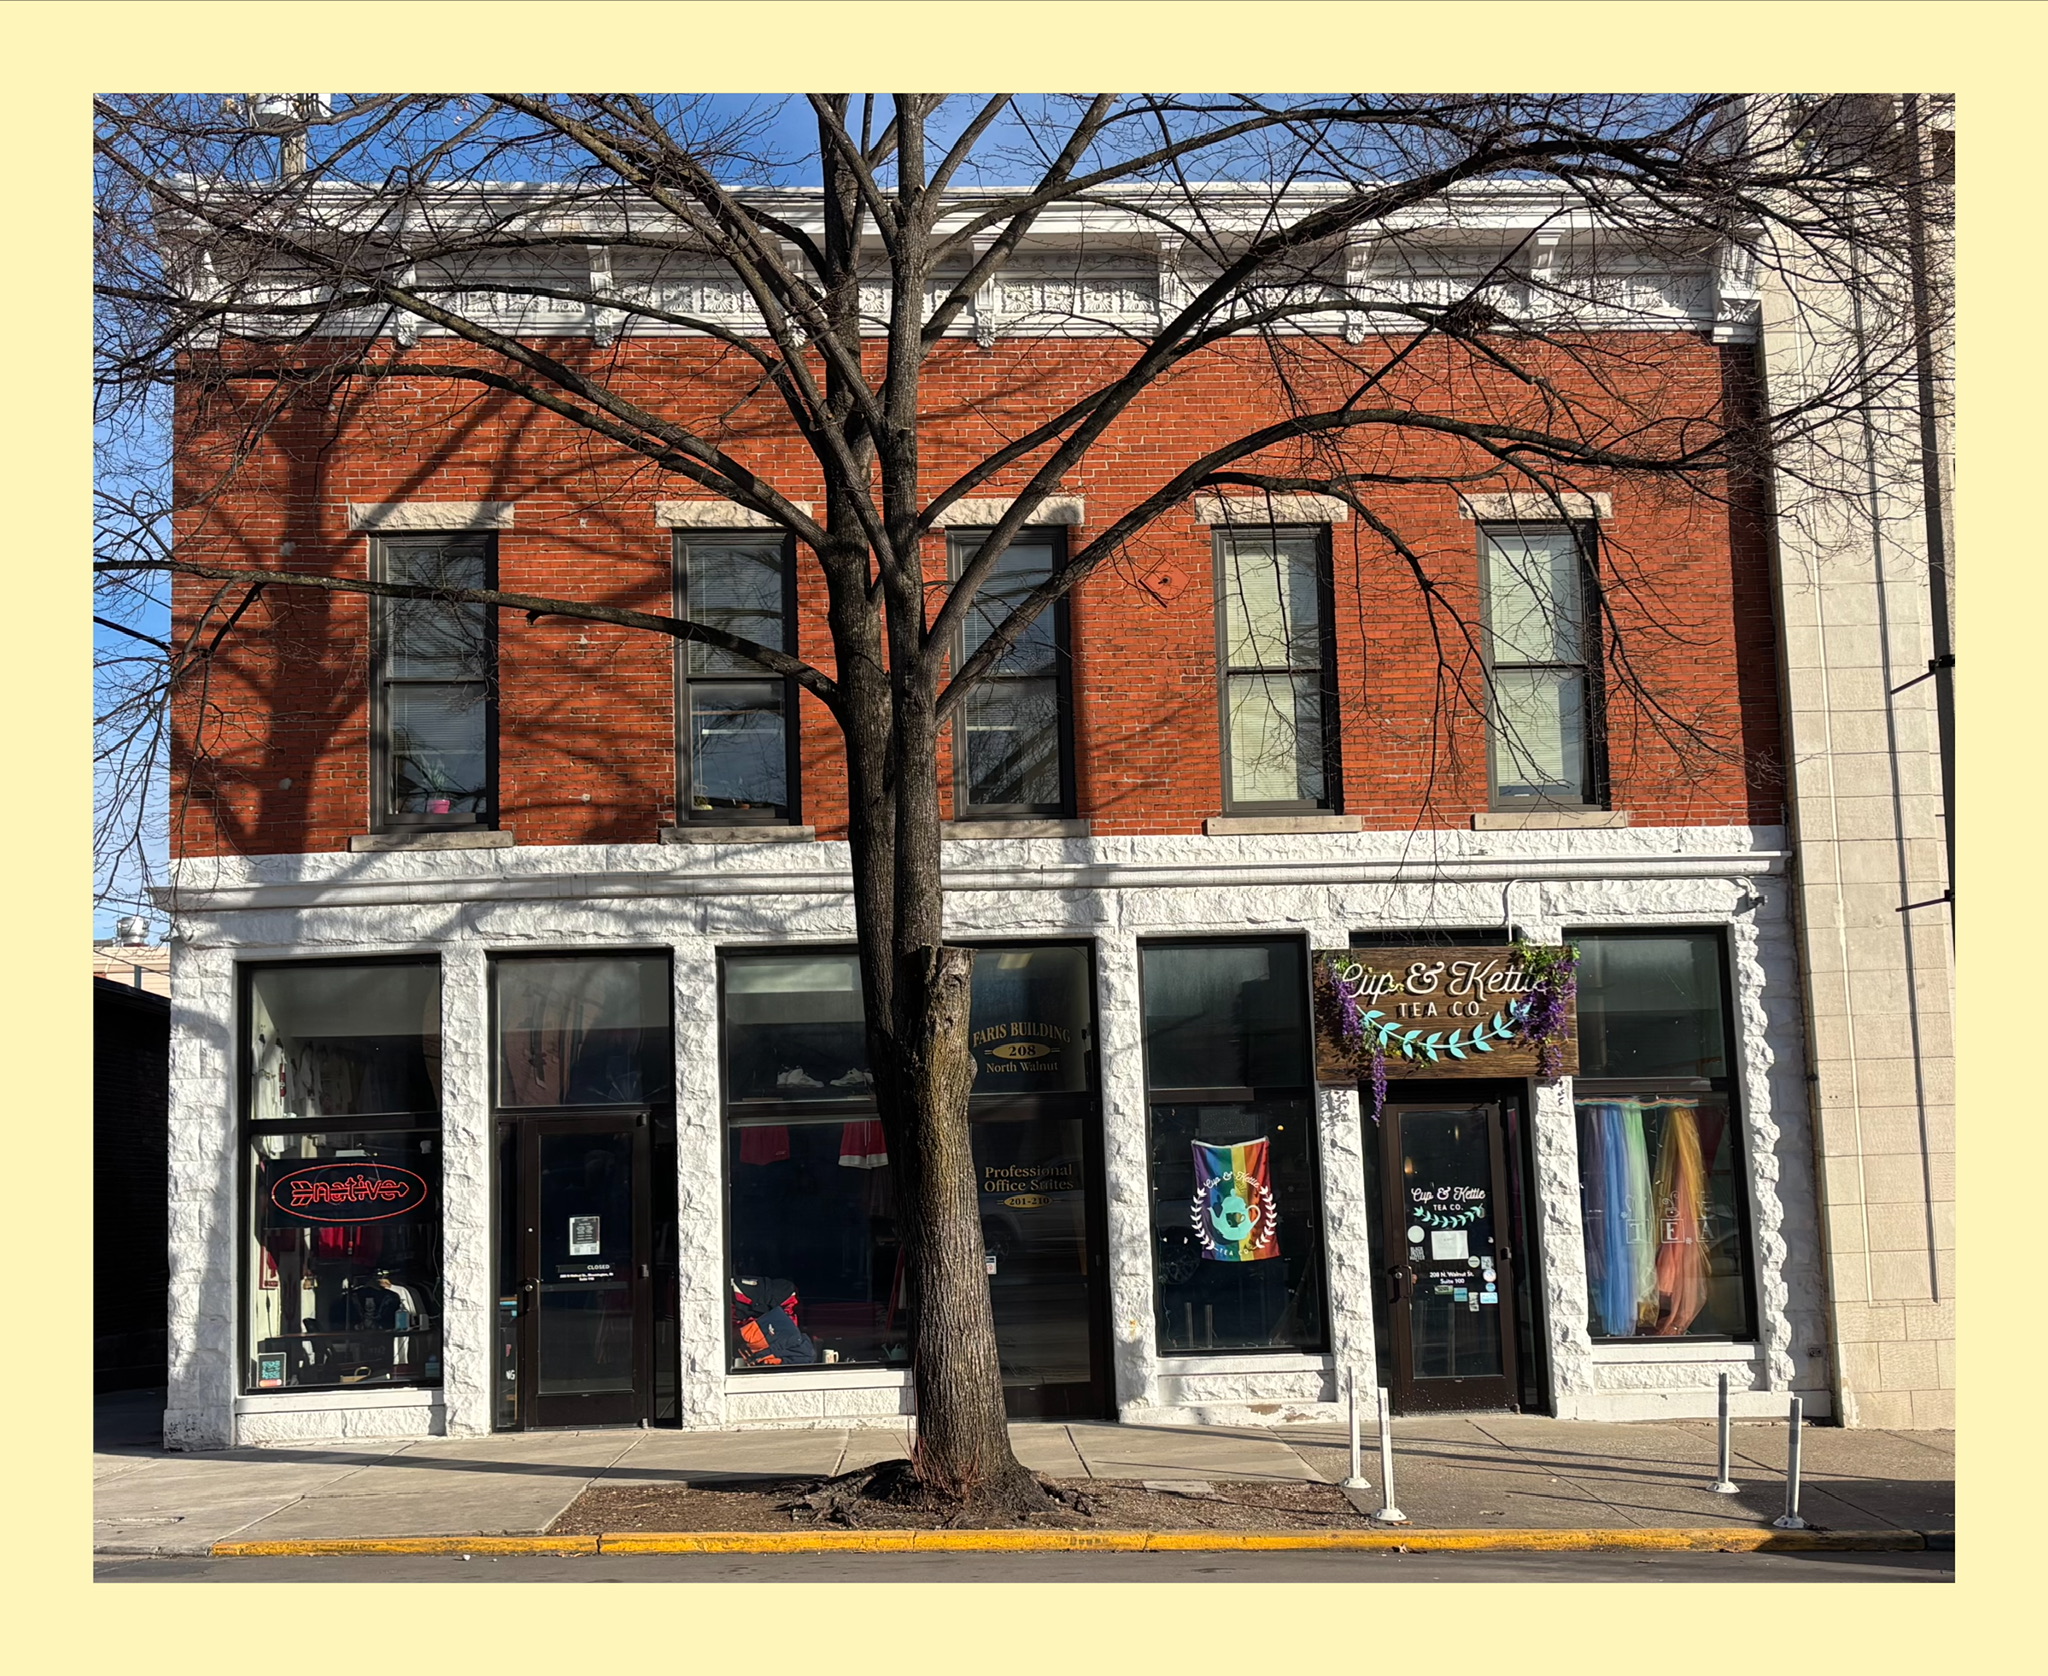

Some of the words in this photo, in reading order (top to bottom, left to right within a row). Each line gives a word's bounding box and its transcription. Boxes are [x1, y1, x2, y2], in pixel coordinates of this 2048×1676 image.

[1407, 961, 1444, 994] &
[1399, 1002, 1438, 1018] TEA
[973, 1023, 1007, 1048] FARIS
[1010, 1022, 1071, 1043] BUILDING
[1008, 1045, 1036, 1057] 208
[986, 1061, 1017, 1073] North
[1020, 1061, 1058, 1072] Walnut
[985, 1163, 1073, 1178] Professional
[313, 1174, 397, 1203] native
[984, 1179, 1026, 1192] Office
[1030, 1179, 1074, 1191] Suites
[1009, 1197, 1050, 1206] 201-210
[1411, 1187, 1434, 1204] Cup
[1436, 1186, 1451, 1200] &
[1453, 1186, 1486, 1203] Kettle
[1449, 1203, 1464, 1211] CO.
[1219, 1248, 1234, 1256] TEA
